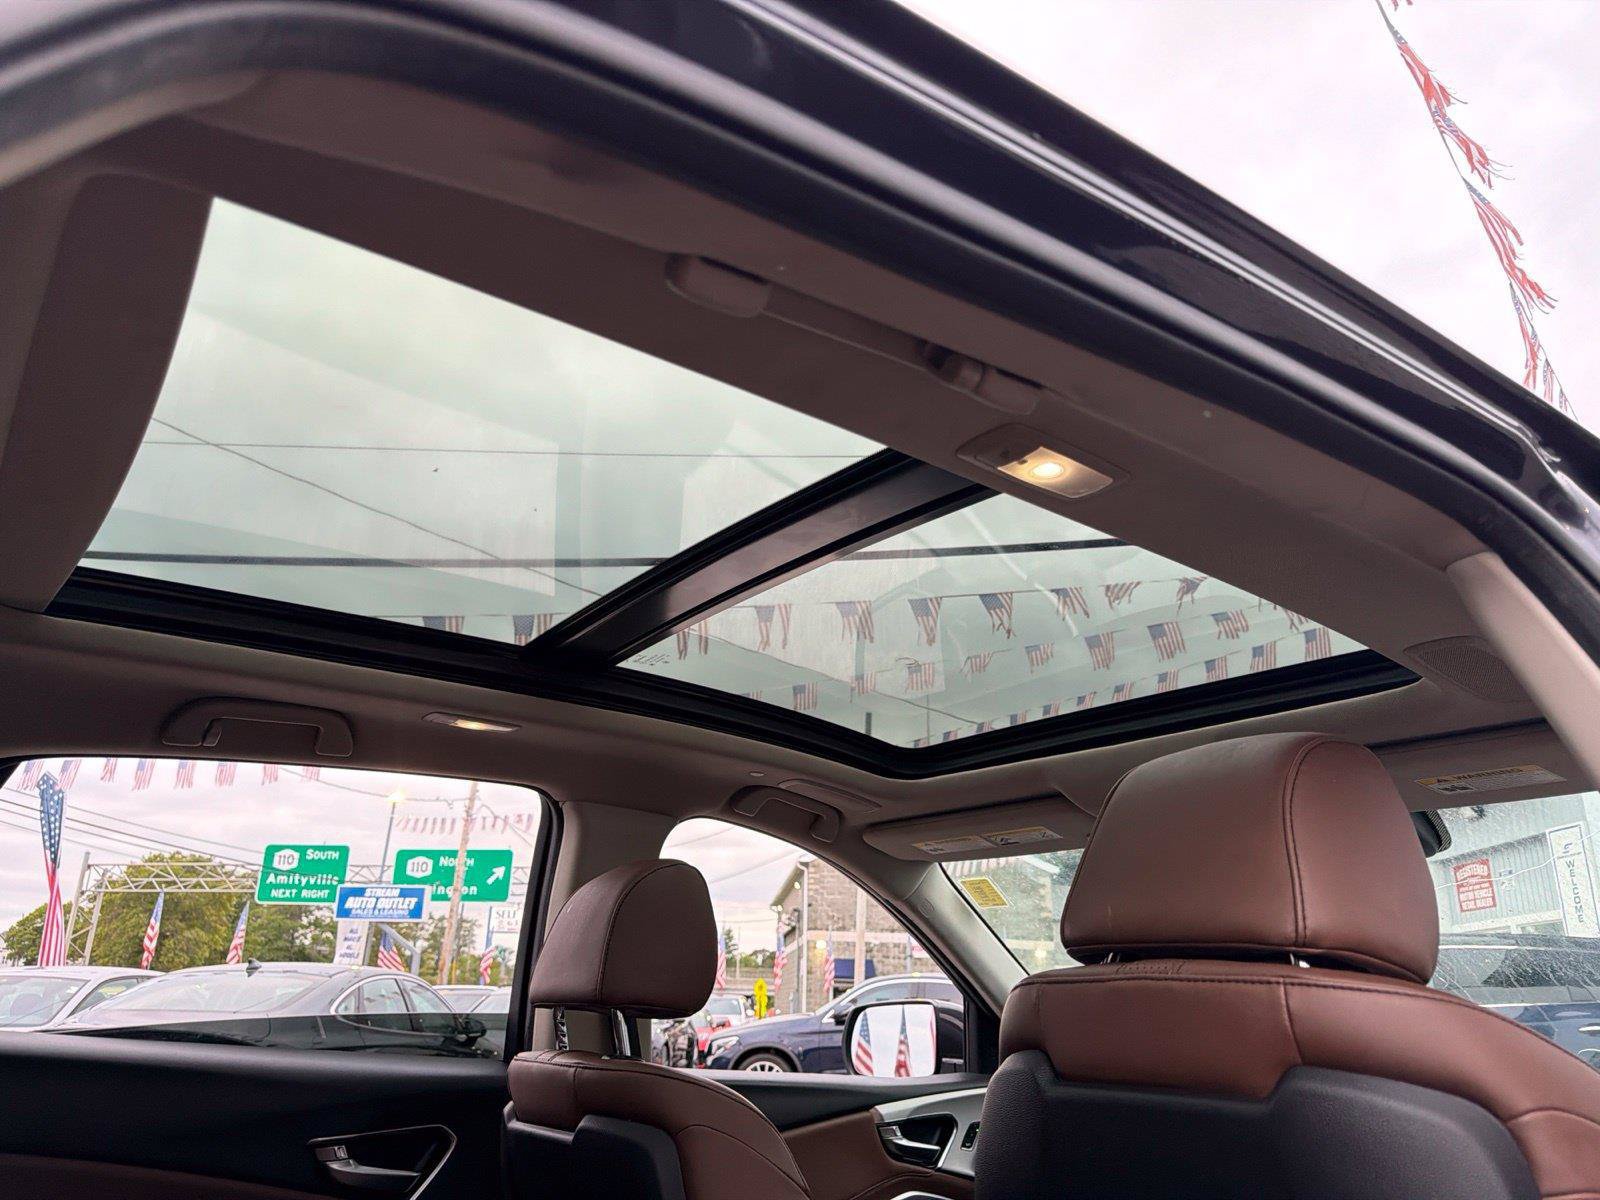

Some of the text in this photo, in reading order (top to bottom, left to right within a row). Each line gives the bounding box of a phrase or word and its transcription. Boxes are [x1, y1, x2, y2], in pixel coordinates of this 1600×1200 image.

[277, 853, 295, 866] 110
[410, 856, 475, 873] 110 NOH
[265, 872, 339, 887] Amityville
[270, 888, 330, 899] NEXT RIGHT
[1565, 859, 1584, 923] WELCOME
[344, 897, 418, 910] AUTO OUTLET
